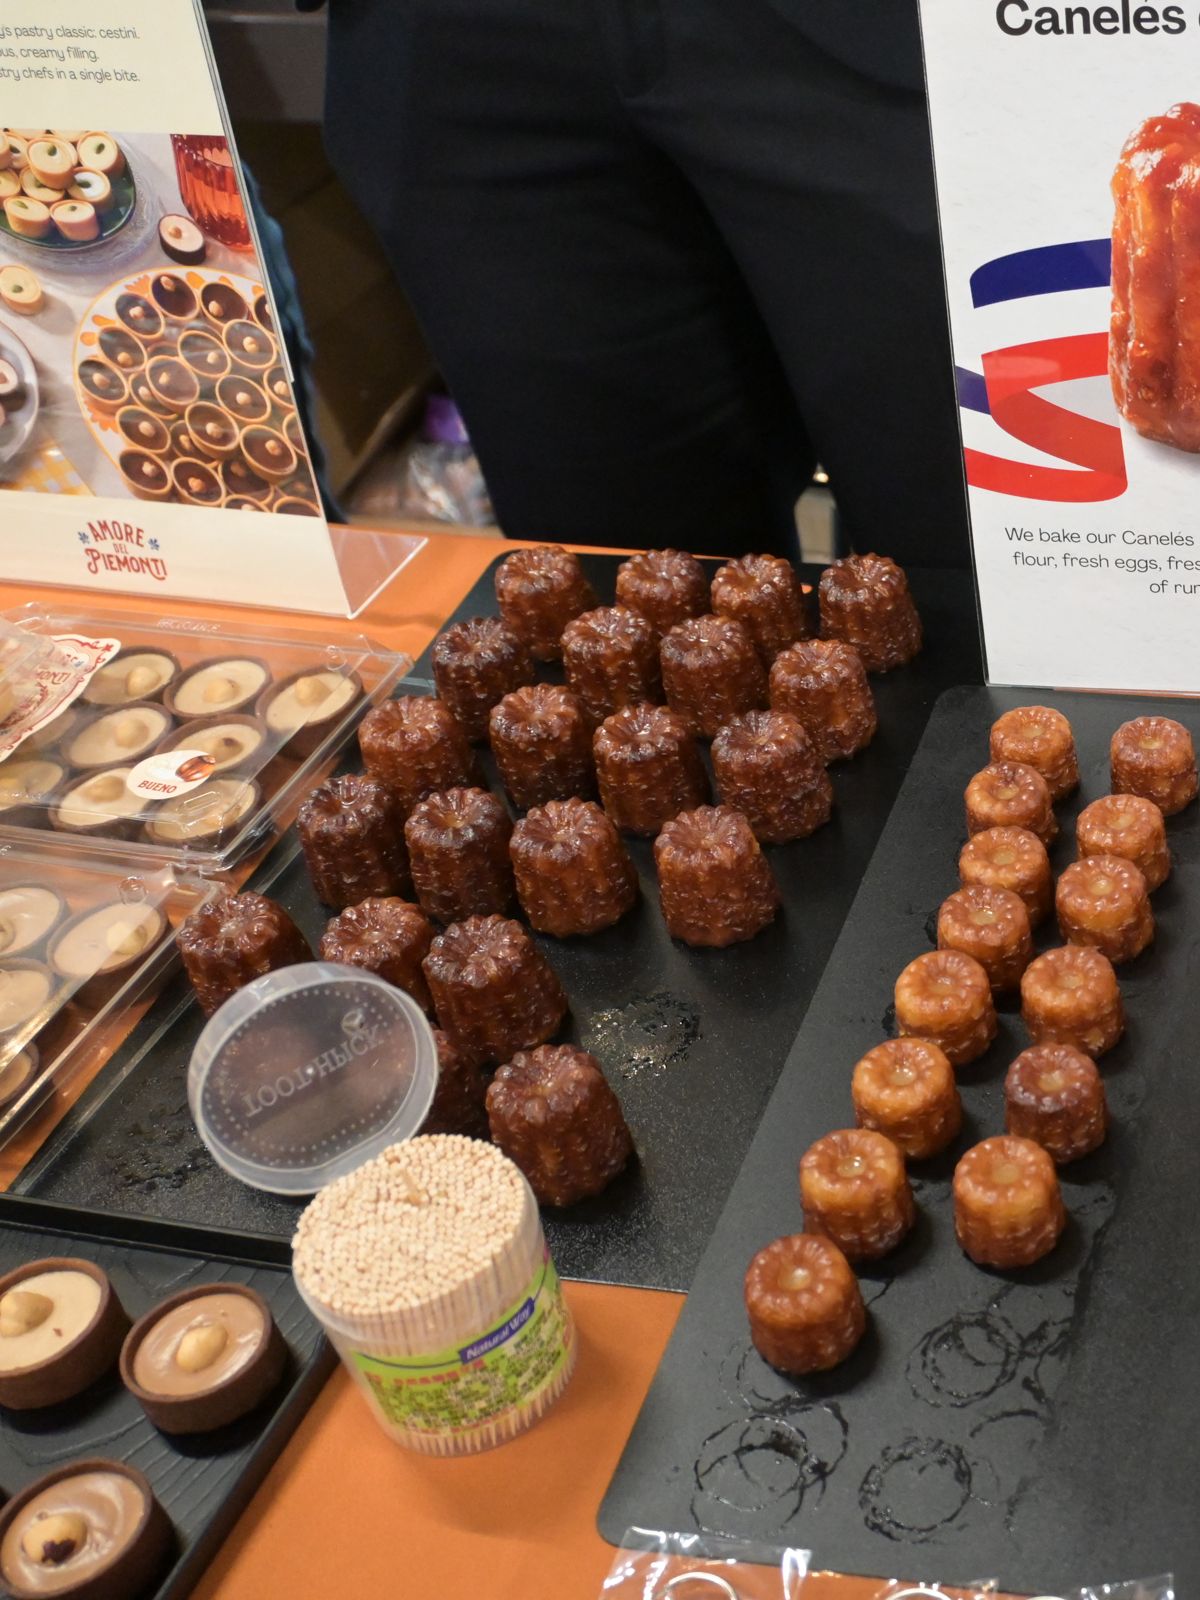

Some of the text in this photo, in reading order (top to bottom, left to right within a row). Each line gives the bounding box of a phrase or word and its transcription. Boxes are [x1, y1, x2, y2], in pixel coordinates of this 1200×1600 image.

[996, 0, 1186, 35] Canelés
[15, 25, 53, 40] pastry
[100, 27, 140, 39] cestini.
[20, 48, 65, 61] creamy
[67, 47, 99, 62] filling.
[23, 67, 54, 79] chefs
[56, 68, 66, 79] in
[69, 70, 77, 80] a
[80, 69, 111, 83] single
[114, 69, 140, 81] bite.
[87, 520, 144, 547] AMORE
[1004, 527, 1034, 541] We
[1039, 528, 1080, 543] bake
[1086, 532, 1116, 544] our
[1122, 530, 1195, 546] Canelés
[84, 548, 167, 581] PIEMONTI
[1013, 551, 1058, 568] flour,
[1062, 553, 1109, 568] fresh
[1114, 556, 1162, 573] eggs,
[1149, 579, 1169, 594] of
[138, 780, 177, 794] BUENO
